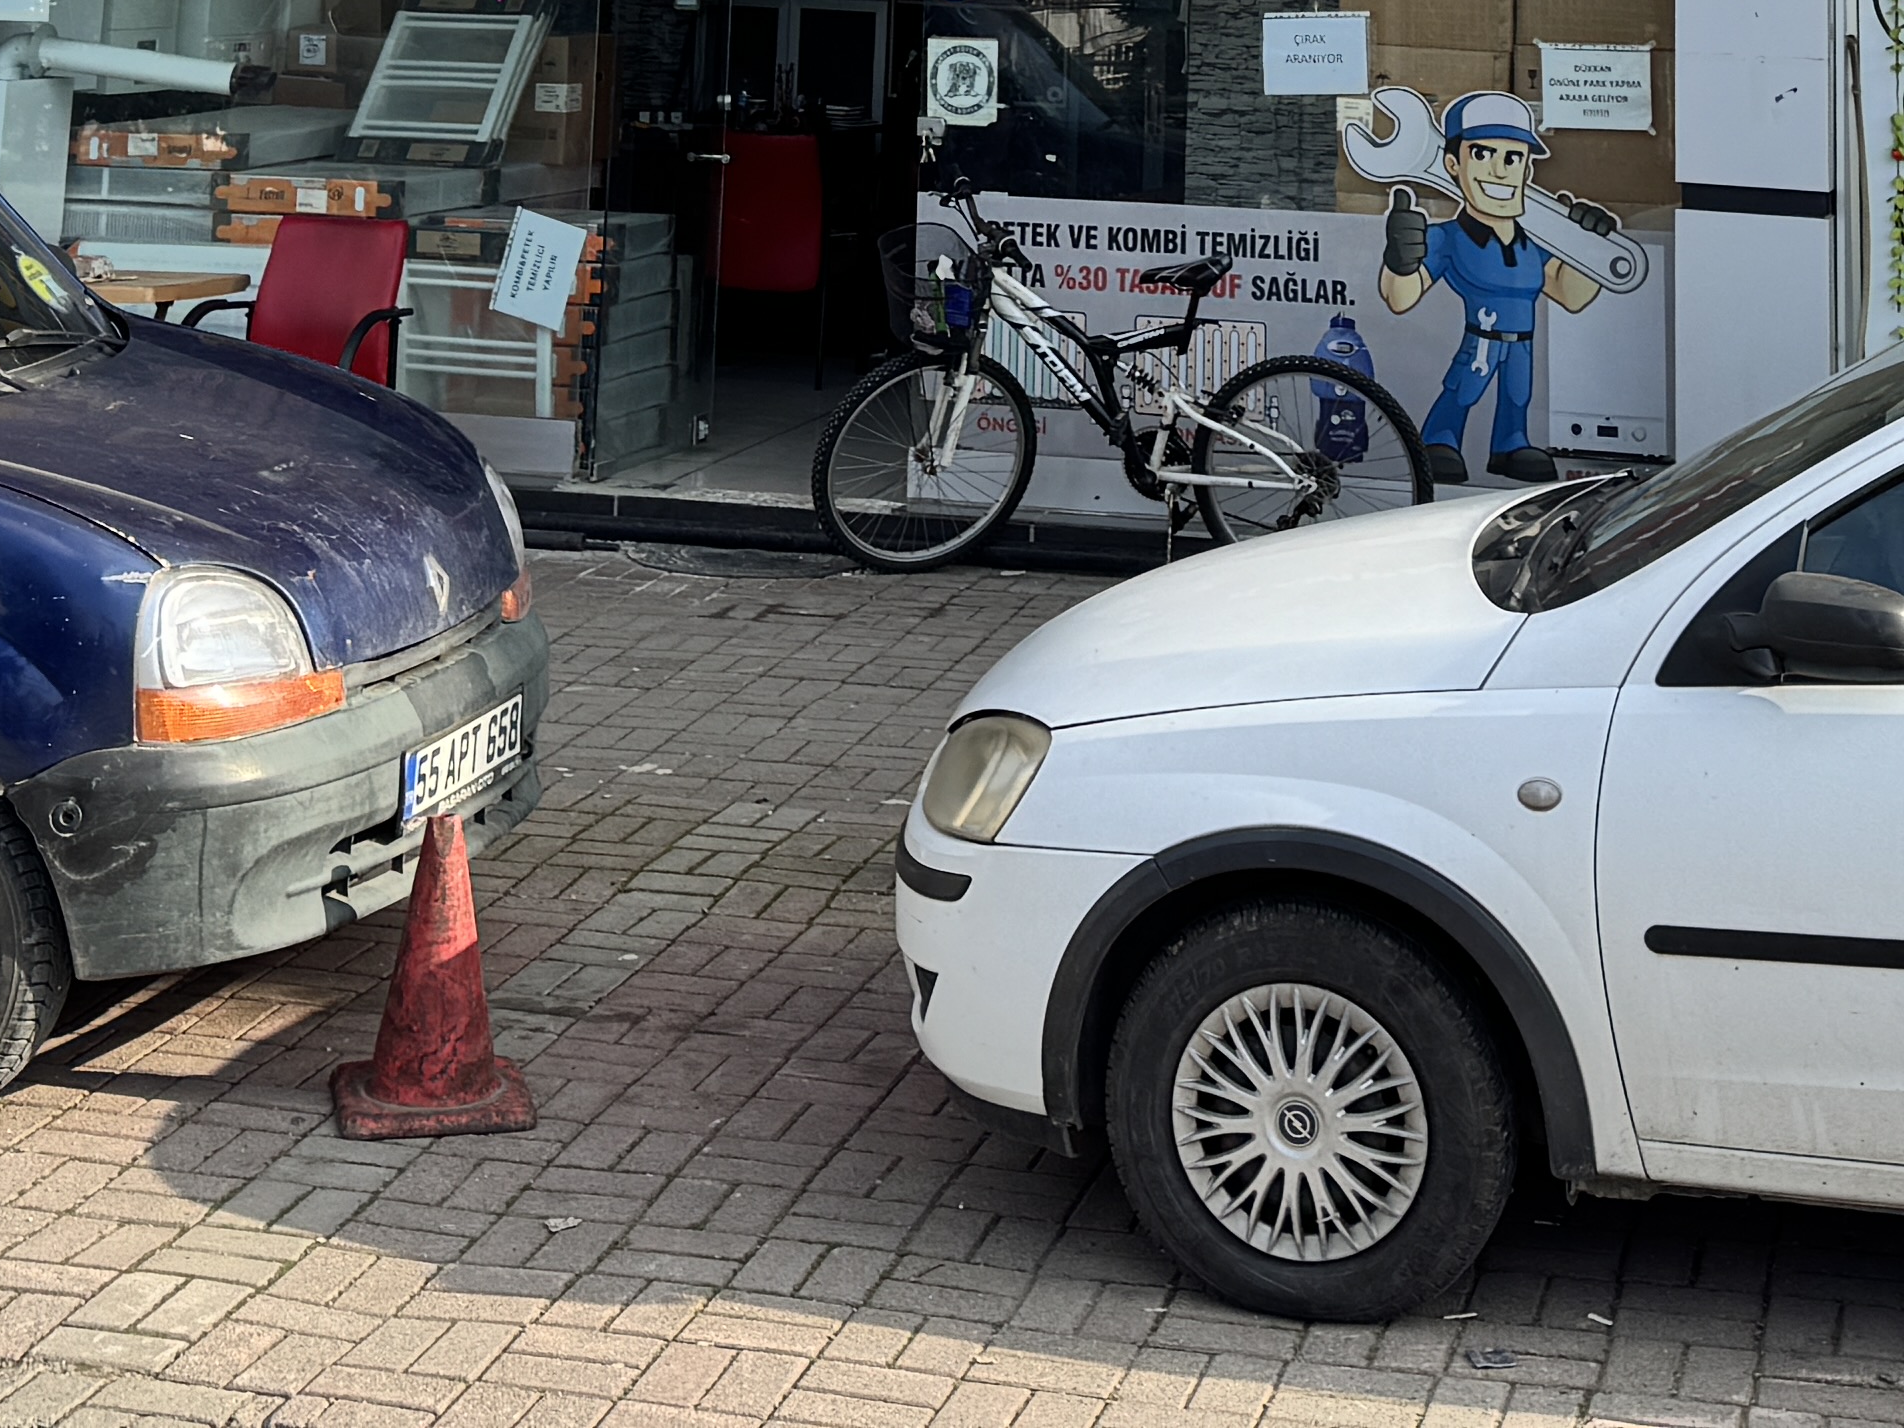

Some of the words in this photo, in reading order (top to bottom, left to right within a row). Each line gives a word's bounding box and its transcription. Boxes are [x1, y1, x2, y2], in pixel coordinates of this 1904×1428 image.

[1284, 52, 1344, 65] ARANIYOR
[1293, 33, 1327, 48] ÇIRAK
[1069, 224, 1098, 249] VE
[1108, 224, 1187, 254] KOMBİ
[1196, 228, 1320, 262] TEMİZLİĞİ
[1055, 264, 1107, 291] %30
[1251, 271, 1356, 306] SAĞLAR.
[416, 747, 440, 805] 55
[445, 723, 482, 789] APT
[487, 701, 519, 764] 658
